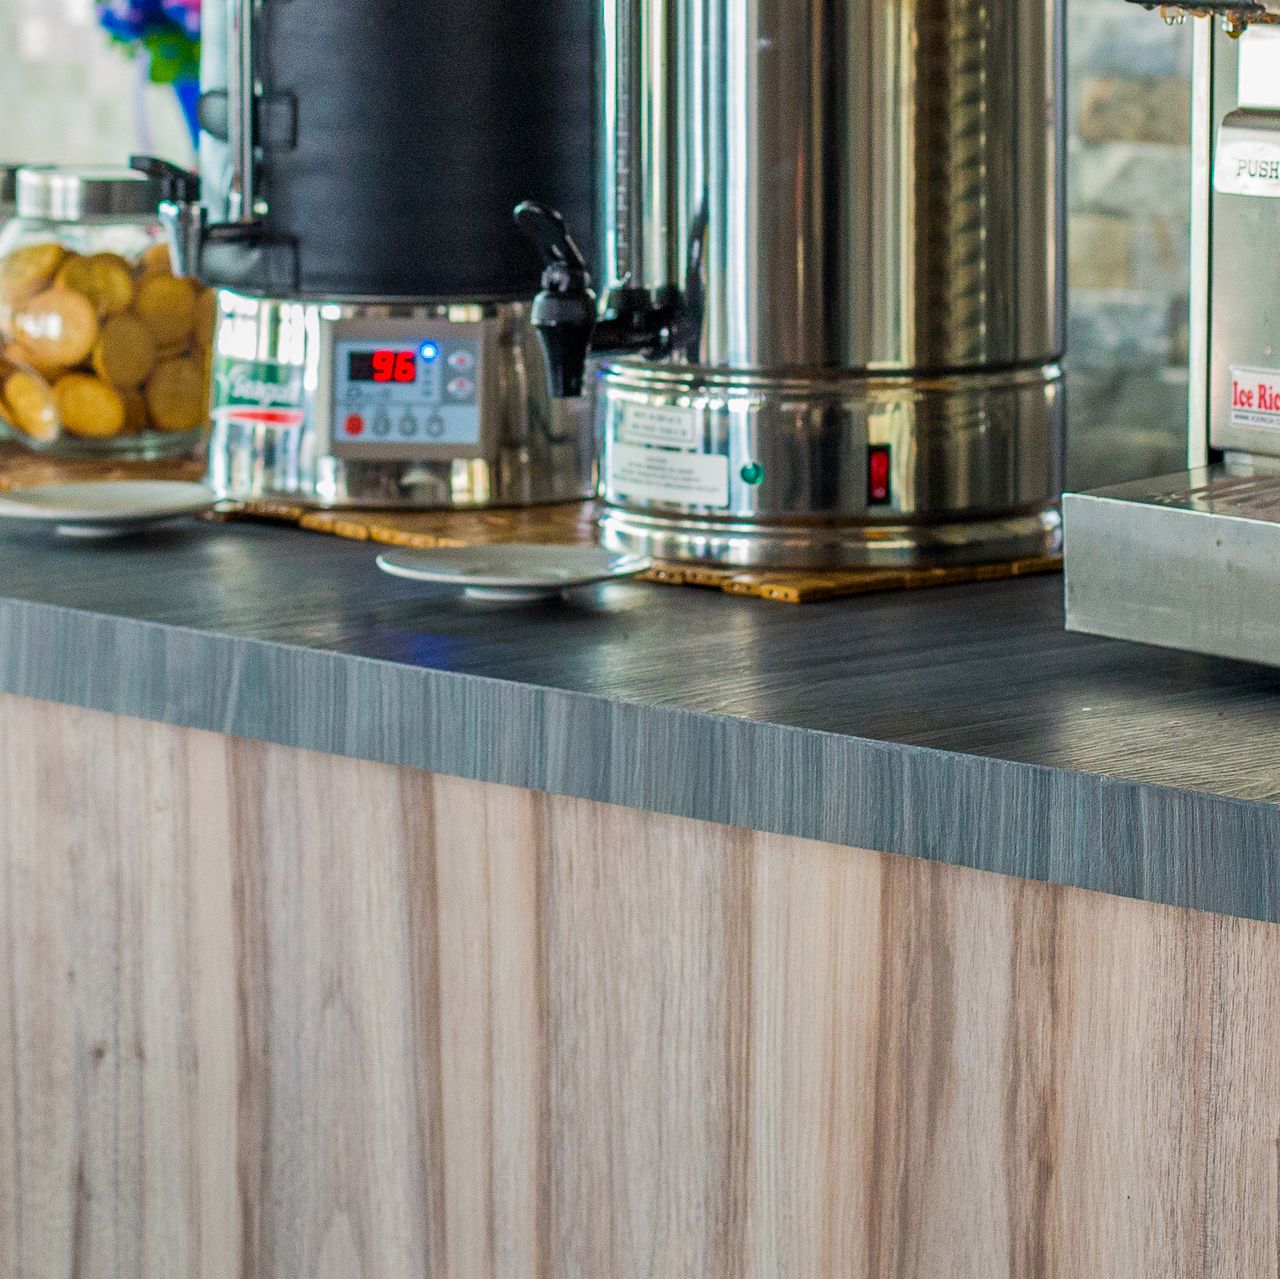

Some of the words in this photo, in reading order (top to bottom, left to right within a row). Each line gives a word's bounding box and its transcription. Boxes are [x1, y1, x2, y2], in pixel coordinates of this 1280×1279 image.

[1236, 159, 1280, 180] PUSH
[372, 350, 416, 383] 96
[1232, 381, 1254, 408] Ice
